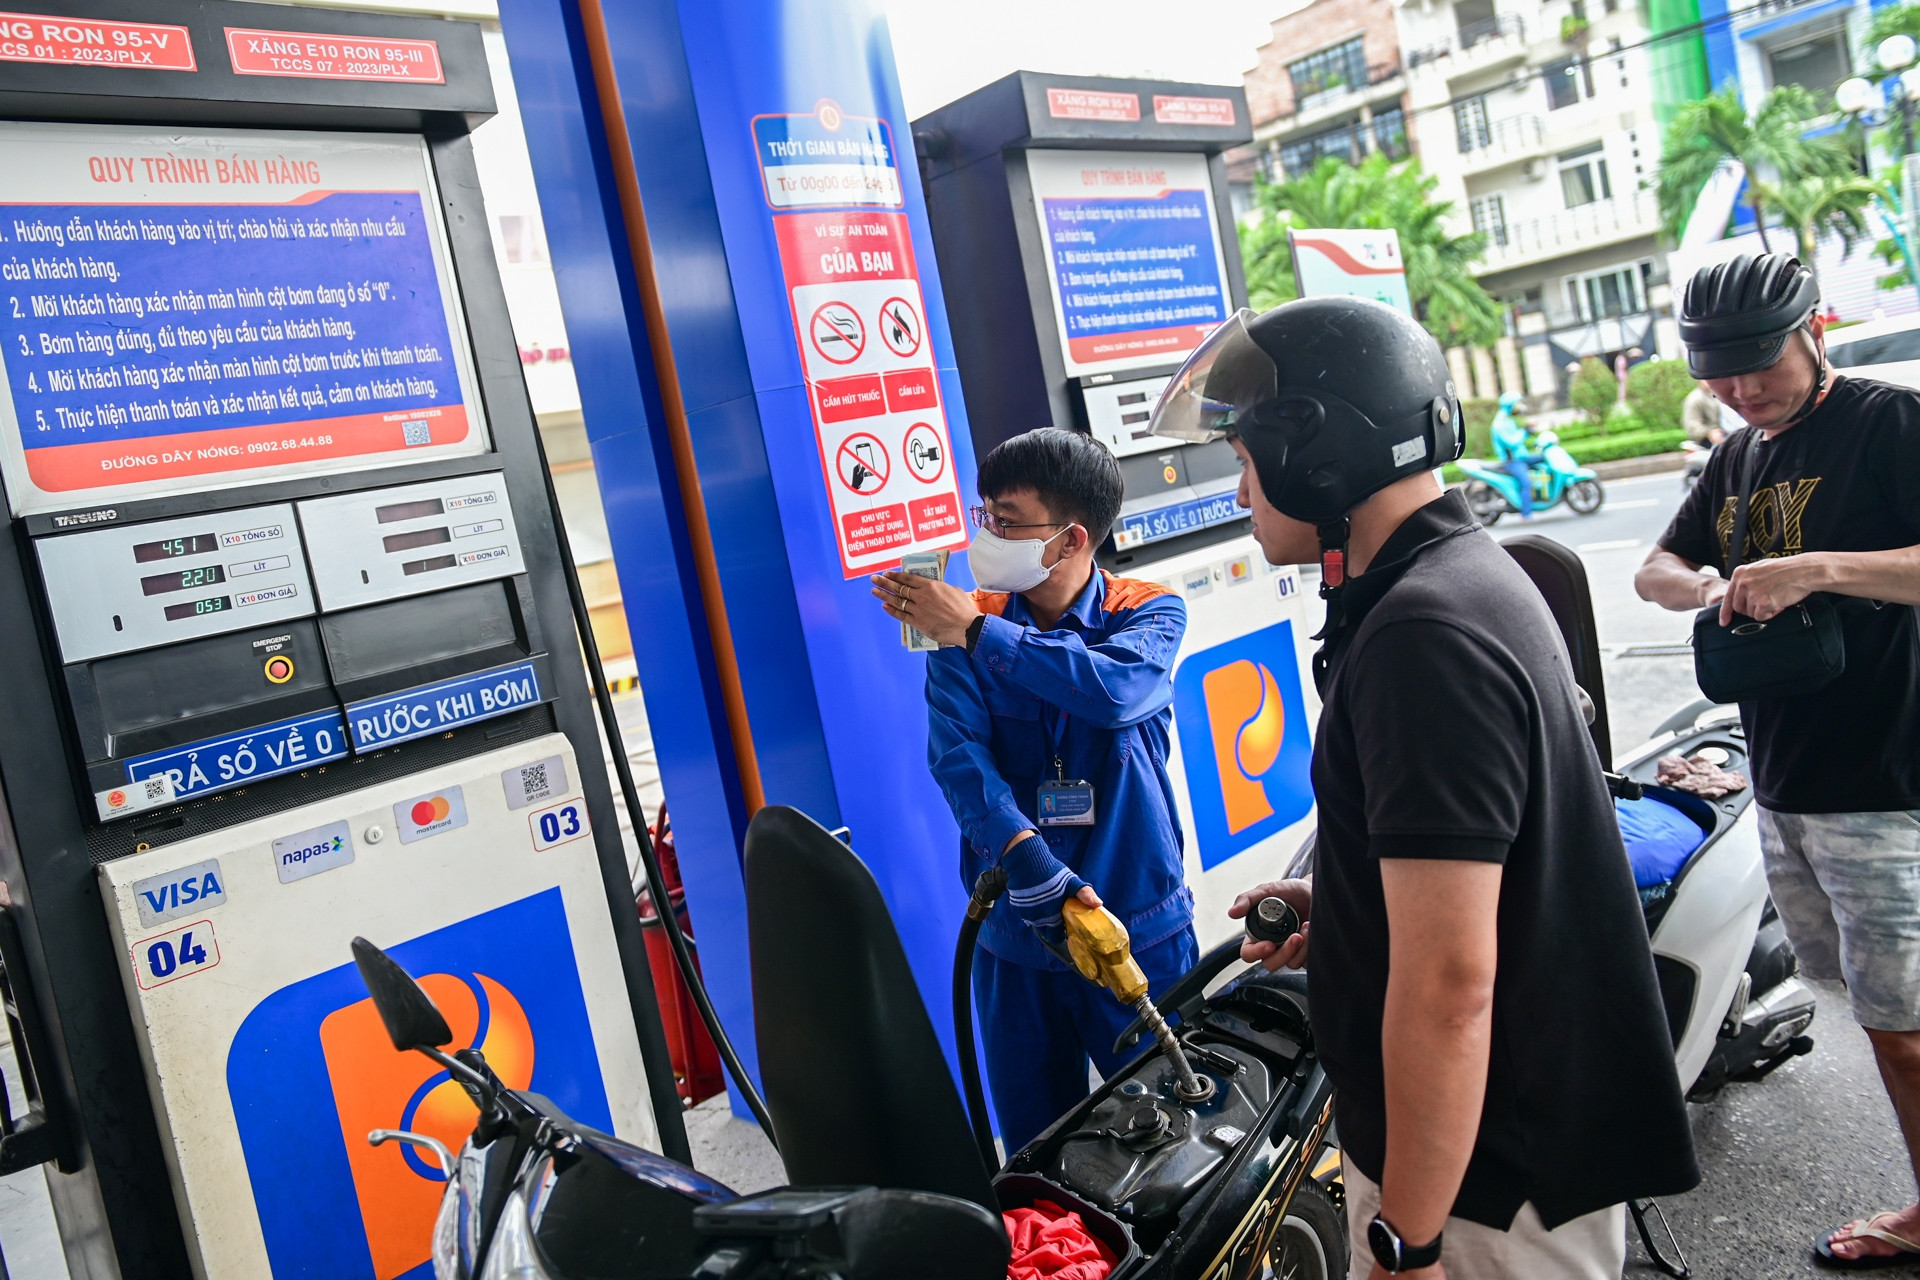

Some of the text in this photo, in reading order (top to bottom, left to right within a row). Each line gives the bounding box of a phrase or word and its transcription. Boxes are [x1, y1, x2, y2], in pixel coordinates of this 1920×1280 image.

[42, 24, 168, 48] RON 95-V
[34, 46, 154, 64] 01 2023/PLX
[247, 38, 424, 63] XĂNG E10 RON 95-III
[270, 58, 410, 76] TCCS 07 2023/PLX
[768, 137, 804, 157] THỜI
[806, 141, 835, 156] GIAN
[837, 138, 861, 157] BÁN
[88, 152, 321, 184] QUY TRÌNH BÁN HÀNG
[777, 177, 797, 191] Từ
[801, 176, 839, 193] 00g00
[66, 215, 406, 245] dẫn khách hàng vào chào hỏi và xác nhận nhu cầu
[816, 222, 888, 240] VÌ SỰ AN TOÀN
[2, 256, 120, 283] của khách hàng.
[820, 246, 894, 276] CỦA BẠN
[31, 284, 347, 318] Mời khách hàng xác nhận màn hình bơm đang
[39, 317, 356, 356] Bơm hàng đúng, đủ theo yêu cầu của khách hàng.
[48, 344, 442, 392] Mời khách hàng xác nhận màn hình bơm trước khi thanh toán.
[56, 377, 438, 432] Thực hiện thanh toán và xác nhận quả, cảm khách hàng.
[823, 390, 881, 408] CẤM HÚT THUỐC
[100, 434, 333, 471] ĐƯỜNG DÂY NÓNG: 0902.68.44.88
[450, 498, 462, 508] X10
[54, 508, 118, 527] TATSUNO
[862, 514, 874, 523] KHU
[1154, 511, 1169, 535] SỐ
[474, 524, 484, 533] LÍT
[851, 524, 874, 538] KHÔNG
[225, 534, 241, 544] X10
[254, 560, 266, 572] LÍT
[463, 554, 476, 563] X10
[476, 550, 492, 560] ĐƠN
[240, 586, 292, 604] X10 ĐƠN GIÁ
[1279, 575, 1294, 596] 01
[196, 598, 222, 614] 053
[252, 634, 292, 648] EMERGENCY
[266, 642, 283, 652] STOP
[218, 678, 533, 780] SỐ VỀ 0 TRƯỚC KHI BƠM
[416, 819, 452, 834] mastercard
[540, 806, 580, 842] 03
[282, 841, 330, 866] napas
[138, 872, 222, 914] VISA
[148, 932, 207, 978] 04
